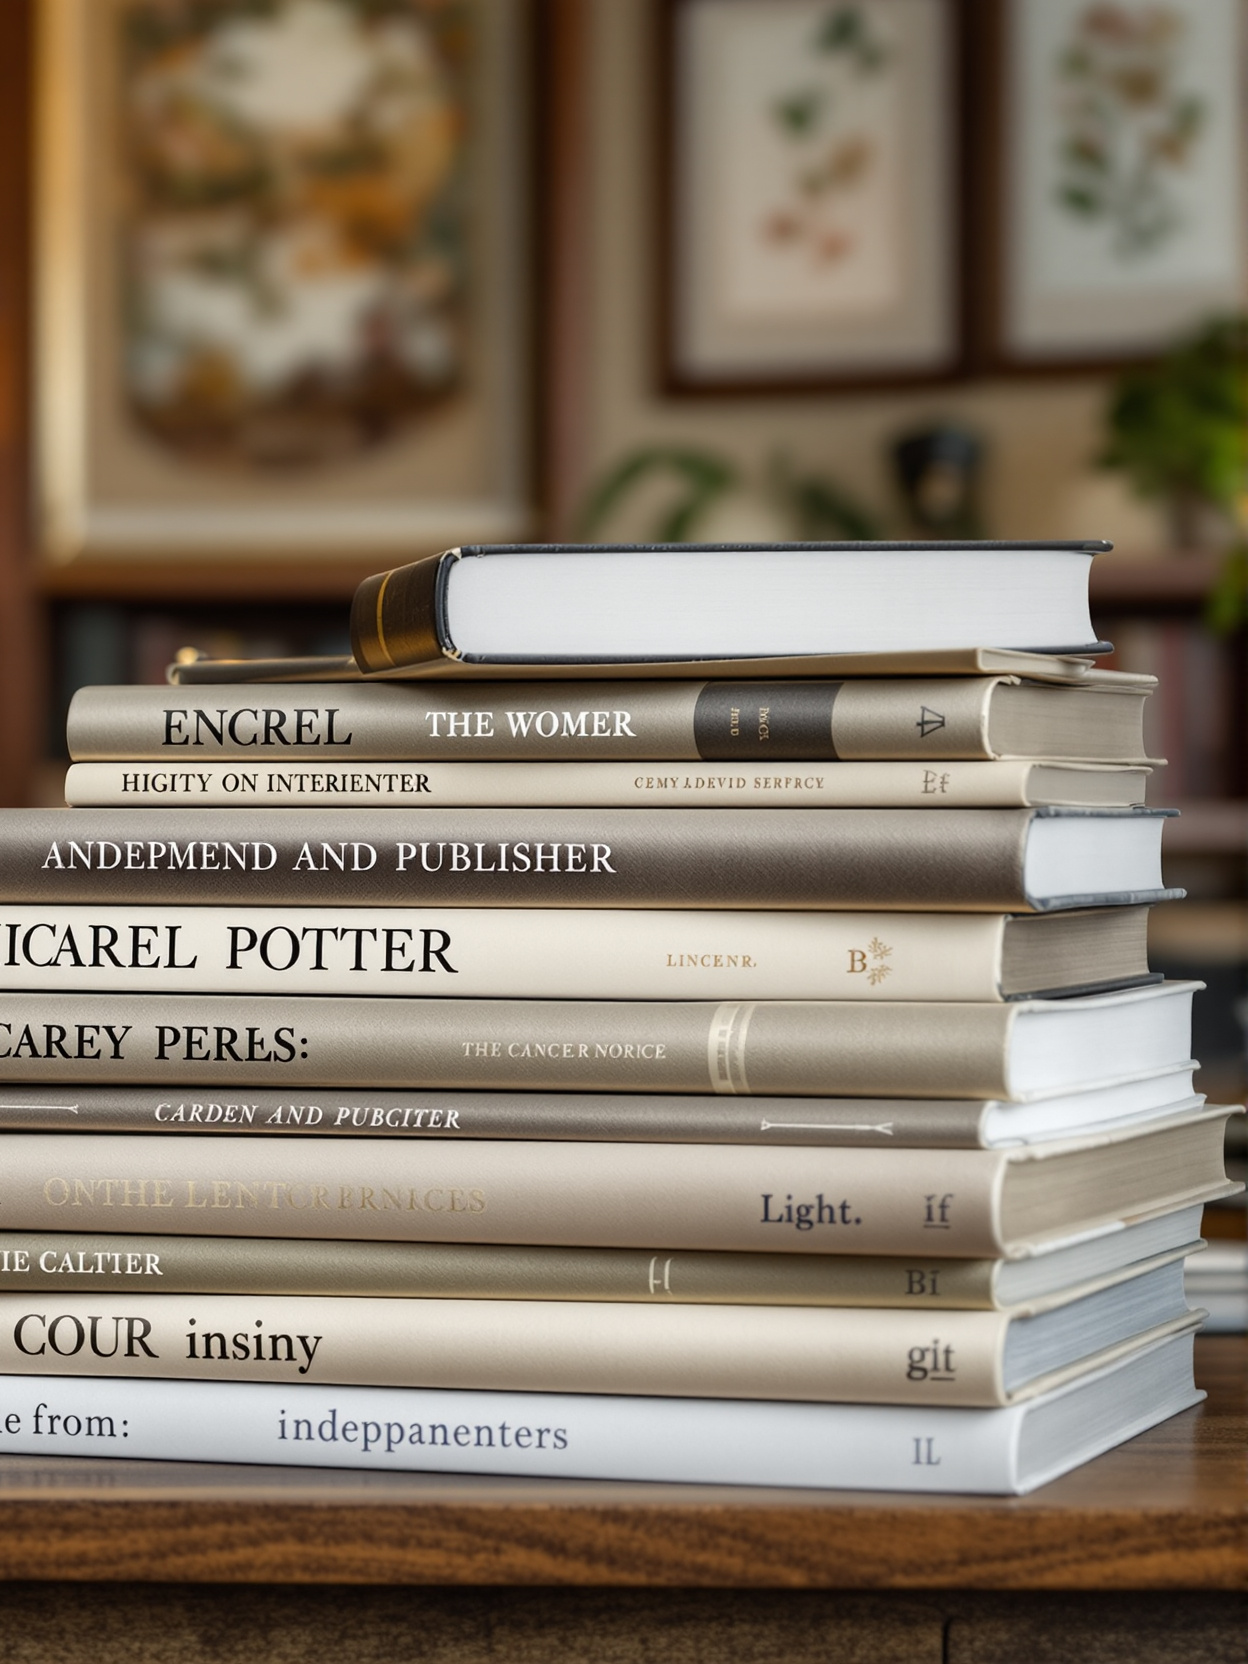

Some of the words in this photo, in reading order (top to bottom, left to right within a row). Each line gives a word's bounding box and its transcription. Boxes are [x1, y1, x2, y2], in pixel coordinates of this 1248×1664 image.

[162, 708, 353, 748] ENCREL
[425, 711, 495, 738] THE
[506, 710, 637, 739] WOMER
[121, 773, 213, 793] HIGITY
[222, 773, 258, 793] ON
[267, 773, 432, 794] INTERIENTER
[41, 841, 278, 871] ANDEPMEND
[292, 842, 378, 871] AND
[395, 842, 617, 873] PUBLISHER
[226, 925, 459, 974] POTTER
[462, 1042, 501, 1057] THE
[154, 1102, 259, 1124] CARDEN
[265, 1104, 324, 1126] AND
[760, 1194, 863, 1231] Light.
[14, 1314, 159, 1359] COUR
[186, 1319, 322, 1374] insiny
[906, 1339, 956, 1381] git
[33, 1406, 130, 1439] from:
[279, 1410, 568, 1455] indeppanenters
